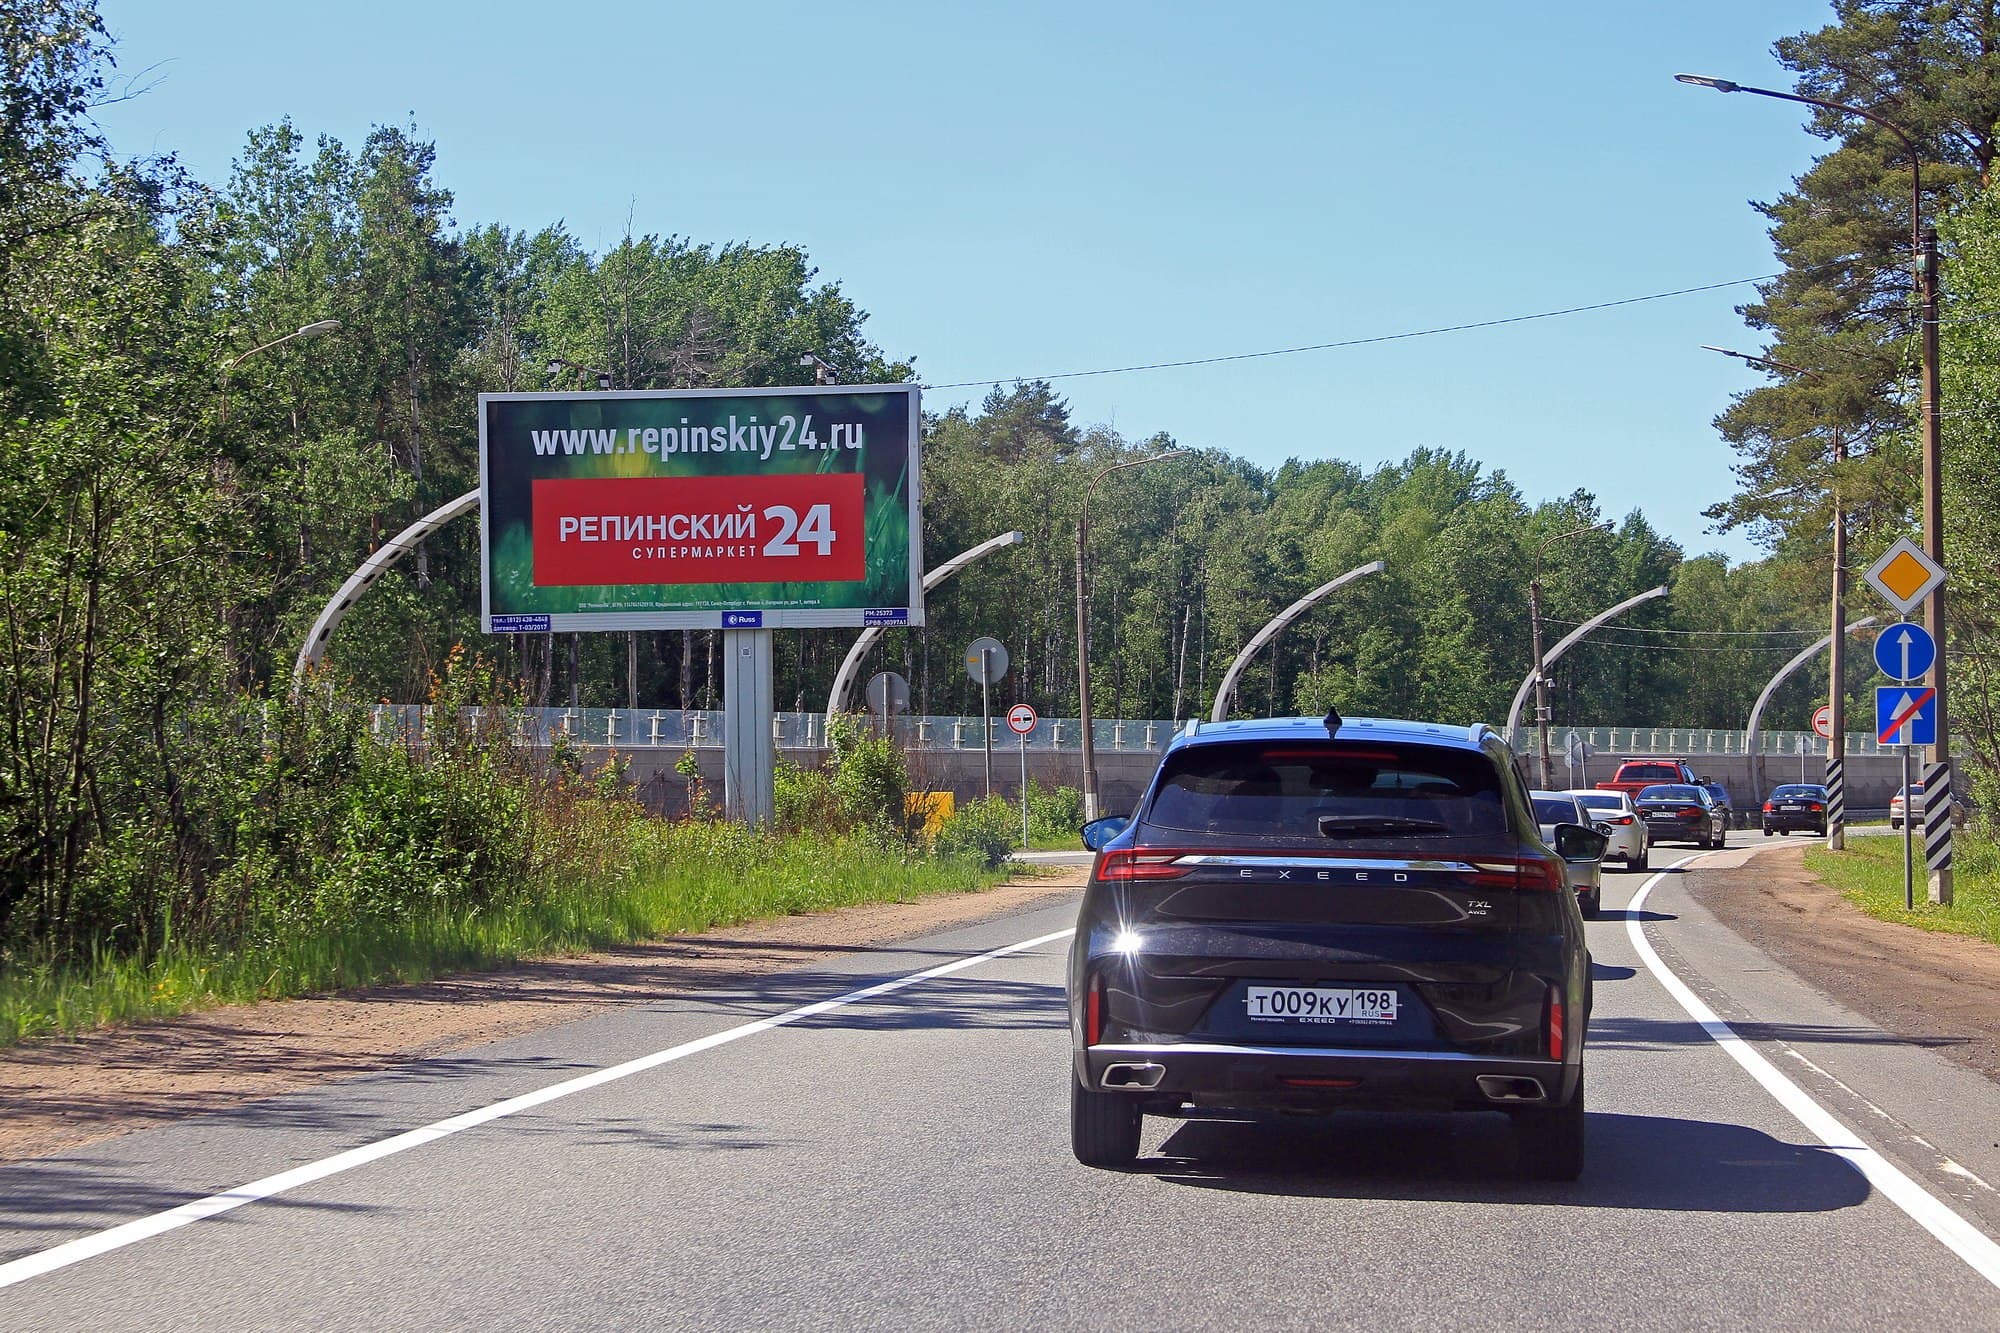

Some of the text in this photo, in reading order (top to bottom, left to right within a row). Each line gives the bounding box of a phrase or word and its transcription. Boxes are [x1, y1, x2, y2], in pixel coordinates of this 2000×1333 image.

[531, 415, 863, 462] www.repinskiy24.ru
[559, 503, 837, 557] РЕПИНСКИЙ 24
[632, 544, 757, 560] СУПЕРМАРКЕТ
[1239, 869, 1407, 882] EXEED
[1467, 900, 1492, 908] TXL
[1355, 991, 1391, 1010] 198
